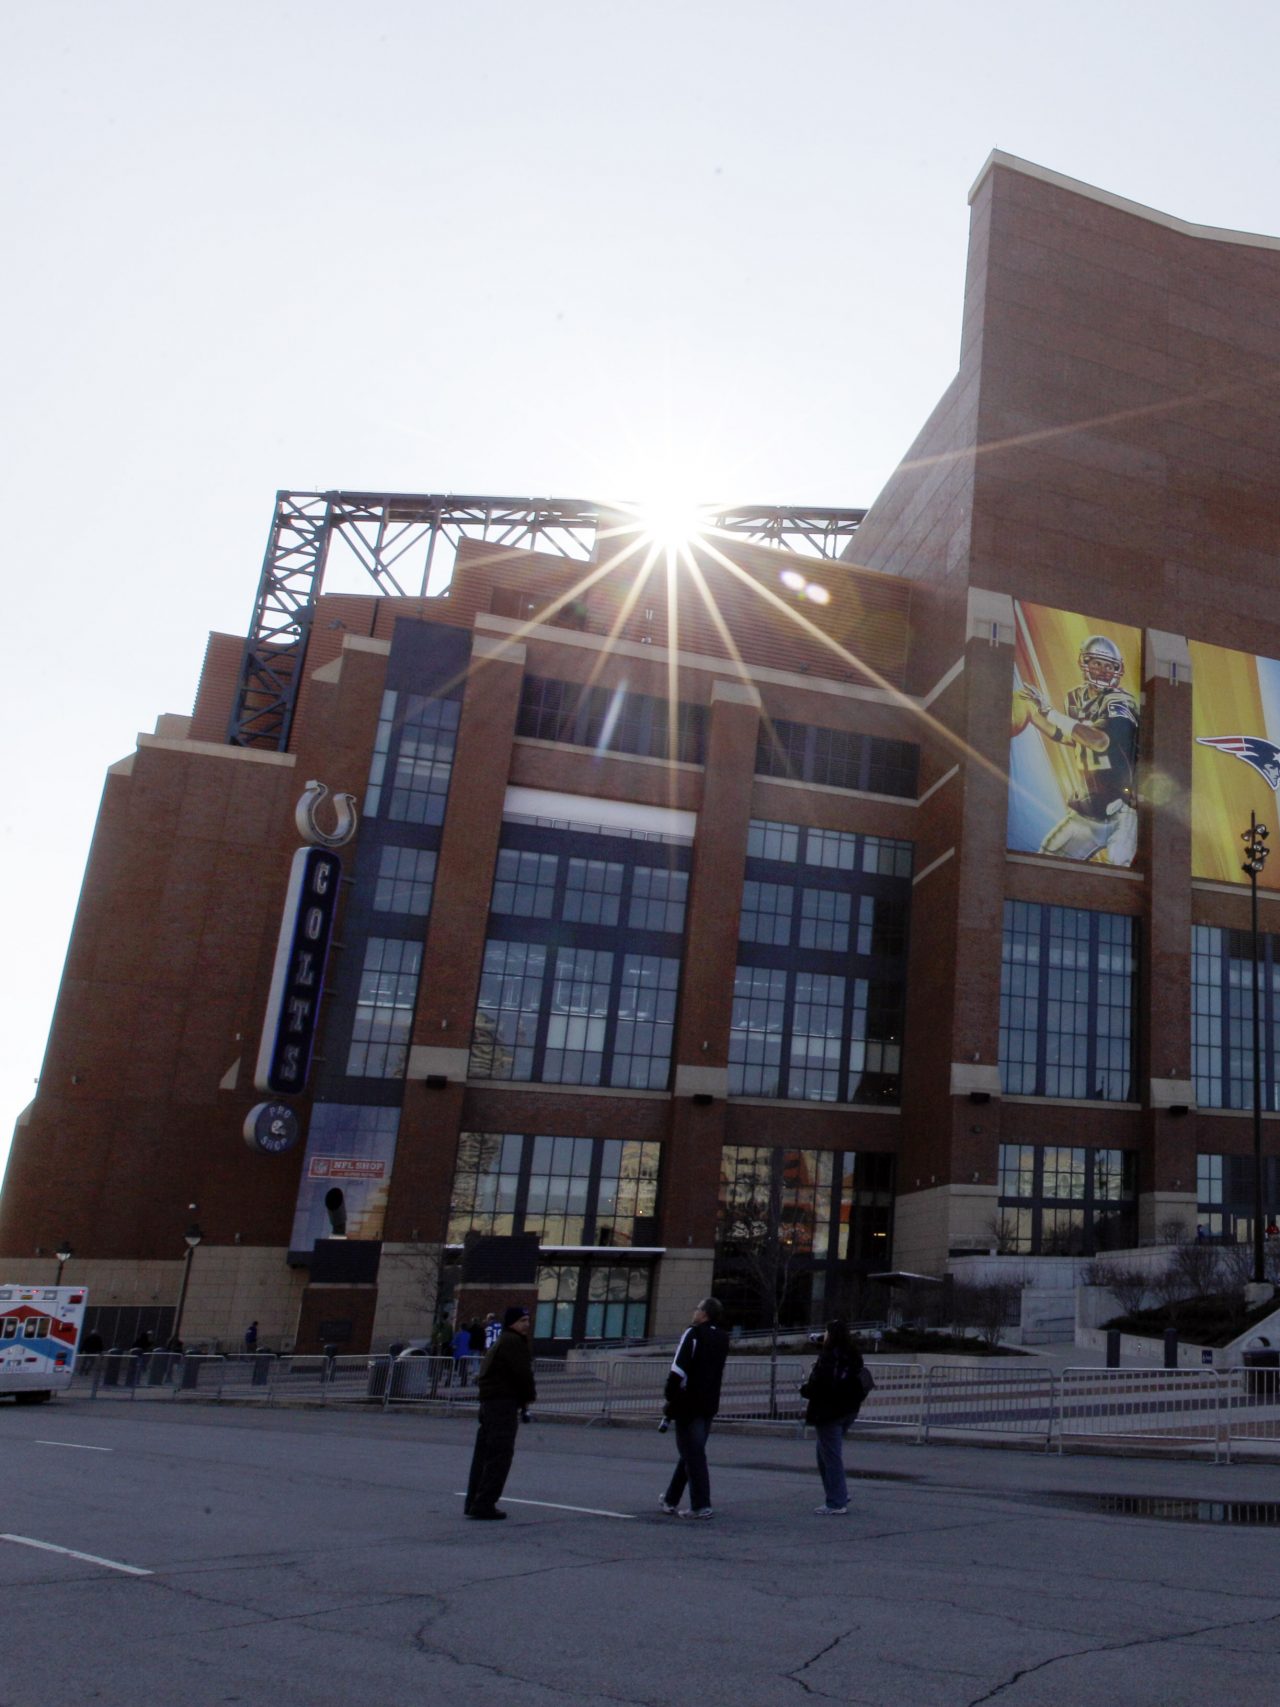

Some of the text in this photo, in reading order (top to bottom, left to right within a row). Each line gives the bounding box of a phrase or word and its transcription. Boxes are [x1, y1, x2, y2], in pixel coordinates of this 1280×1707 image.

[279, 860, 332, 1082] COLTS
[269, 1105, 292, 1119] PRO
[260, 1135, 288, 1151] SHOP
[334, 1161, 386, 1171] NFL SHOP
